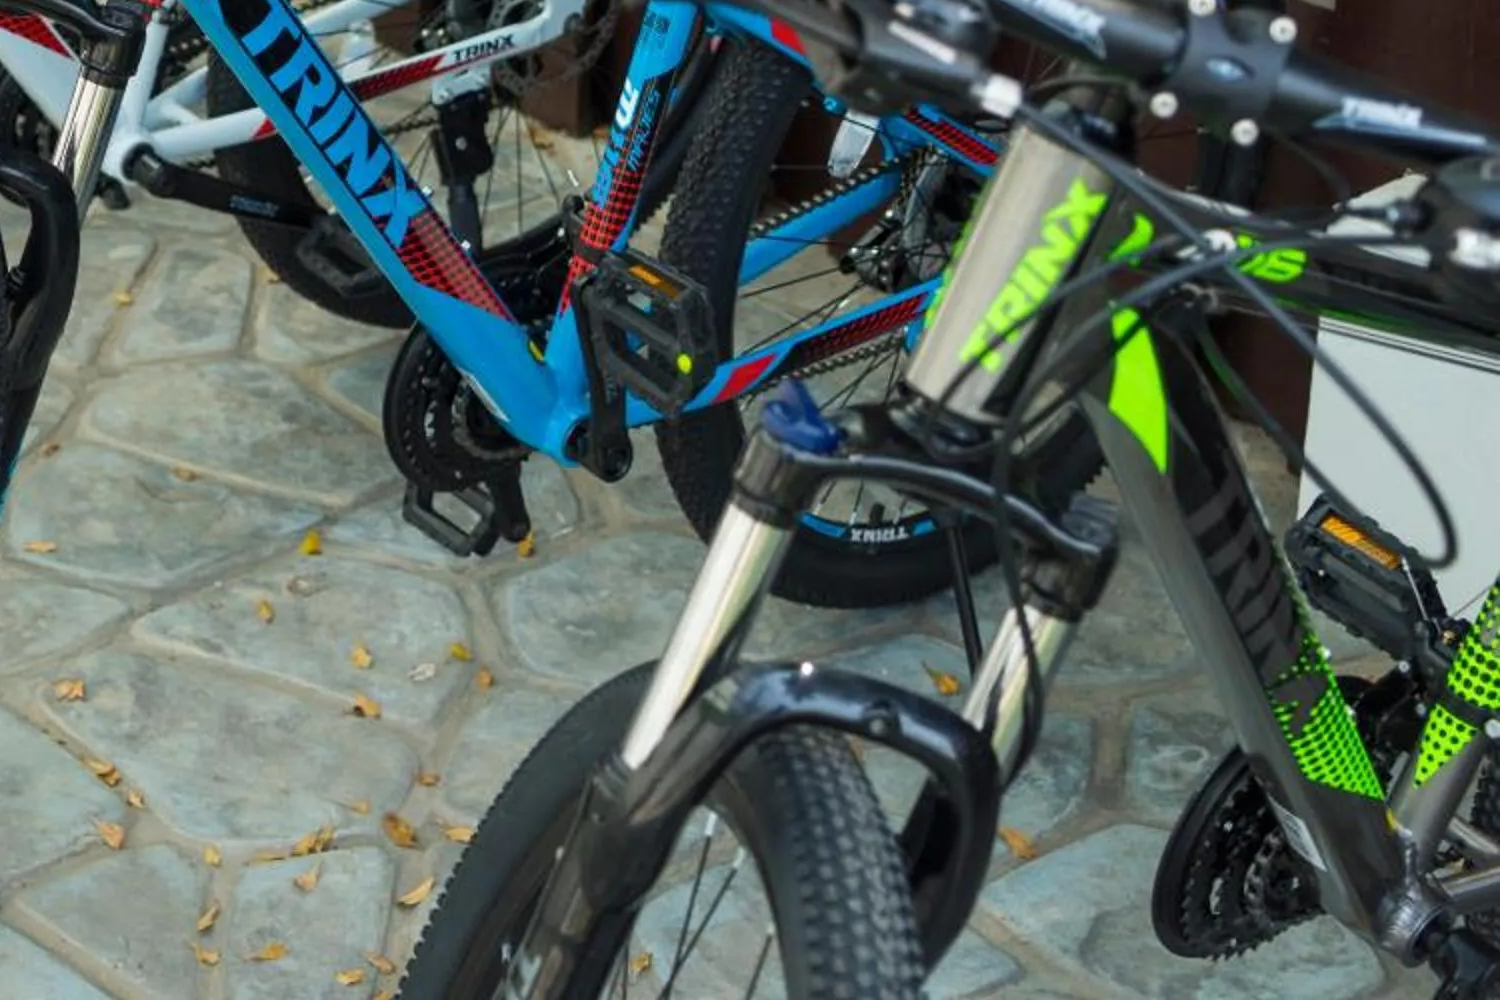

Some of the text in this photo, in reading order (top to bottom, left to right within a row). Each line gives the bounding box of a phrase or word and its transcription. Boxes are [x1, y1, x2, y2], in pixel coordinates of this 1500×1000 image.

[452, 34, 515, 62] TRINX
[958, 176, 1108, 374] TRINX
[848, 526, 911, 543] TRINX
